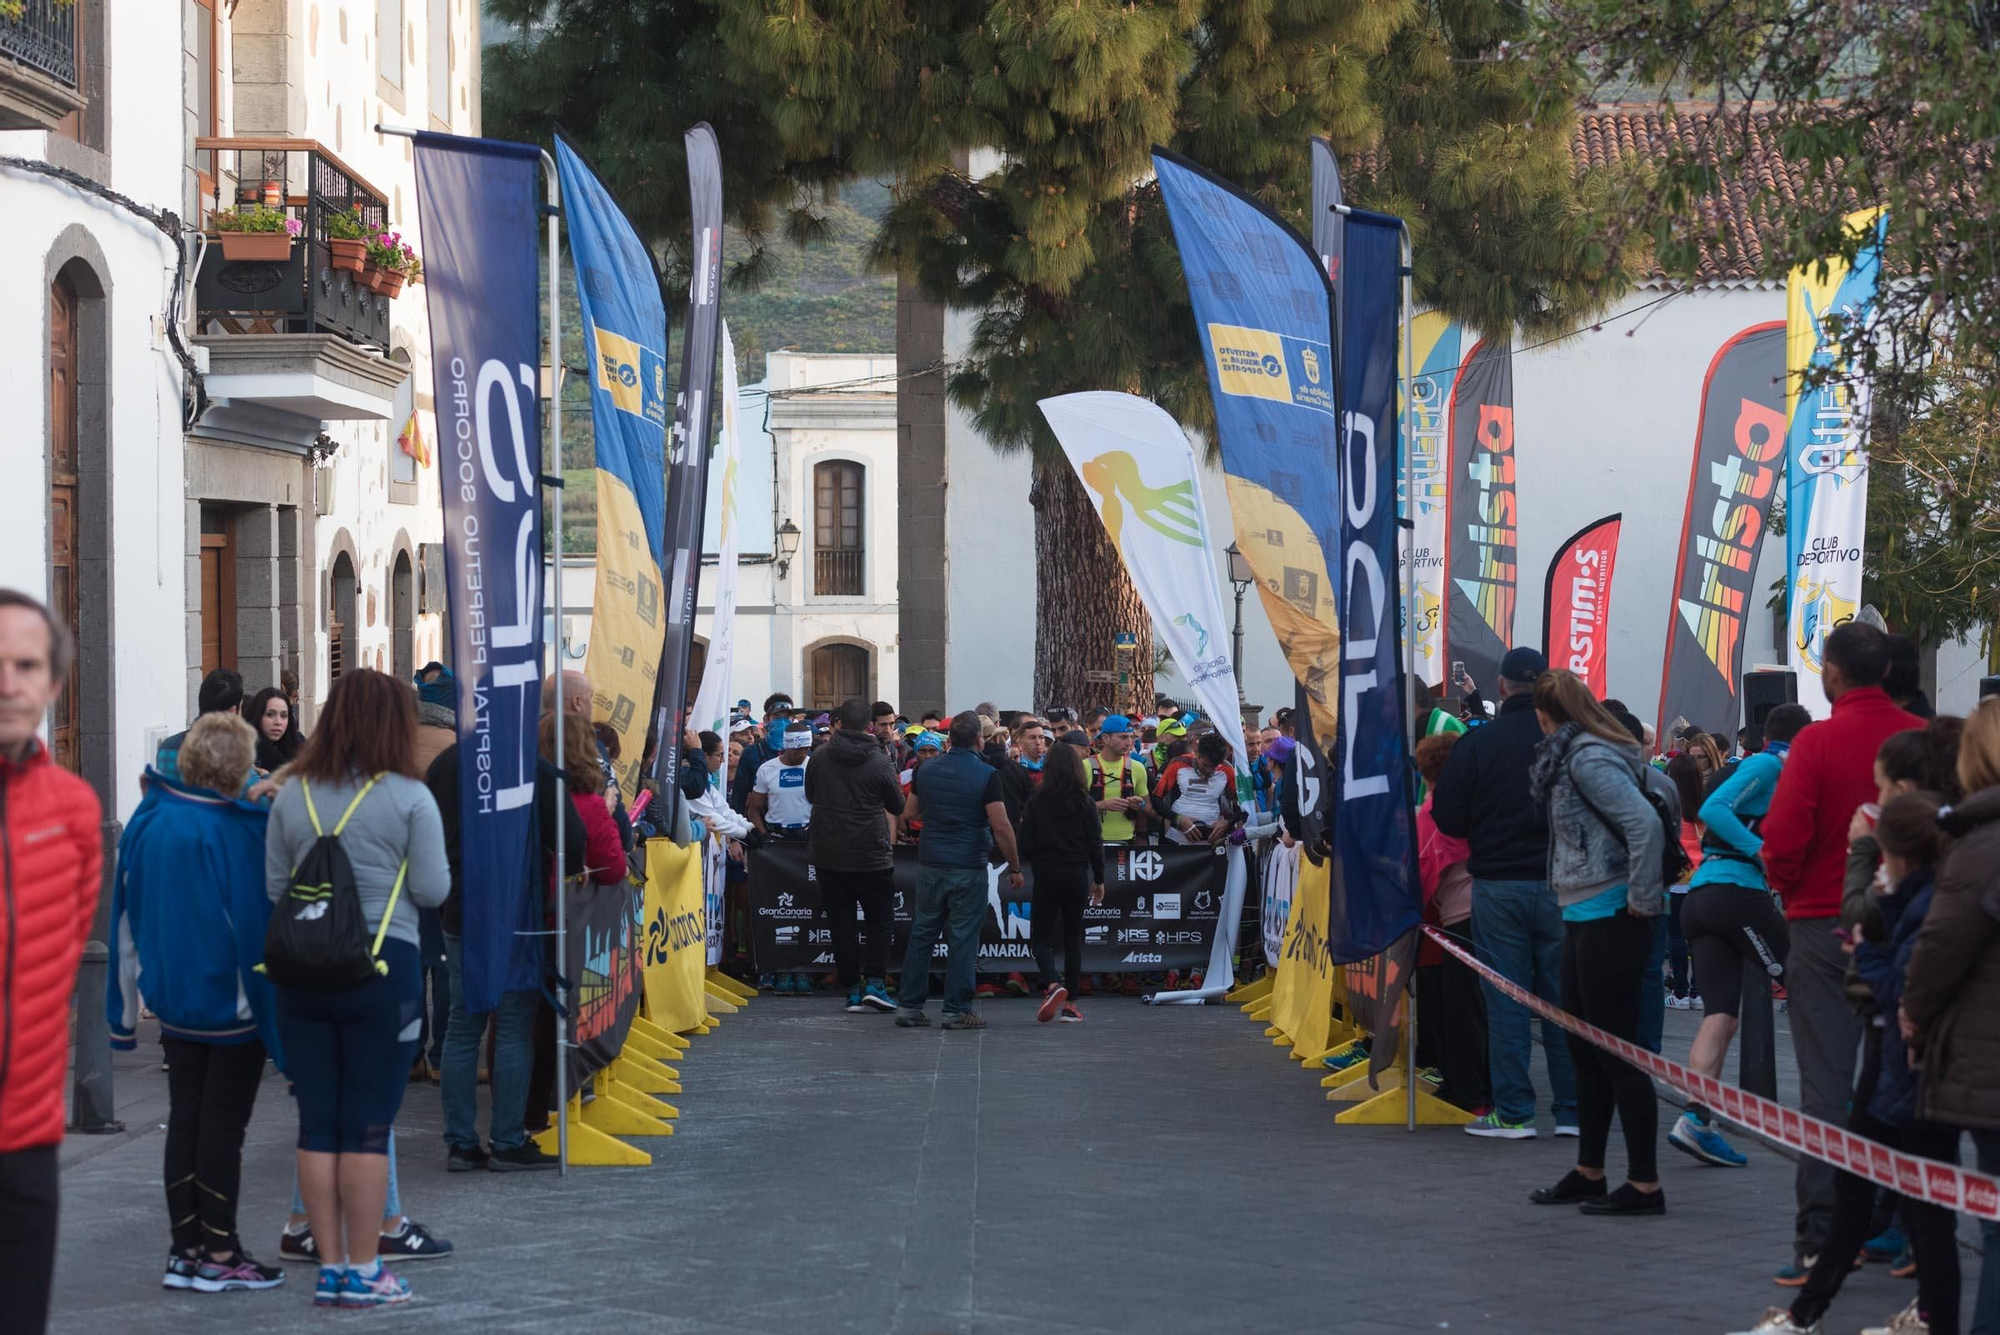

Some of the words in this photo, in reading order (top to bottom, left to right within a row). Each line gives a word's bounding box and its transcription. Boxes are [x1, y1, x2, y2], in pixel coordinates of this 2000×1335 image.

[1453, 404, 1517, 650] Arista
[1678, 397, 1787, 697] Arista
[1812, 536, 1839, 551] CLUB
[1402, 548, 1430, 559] CUB
[1796, 548, 1860, 566] DEPORTIVO
[1398, 557, 1444, 569] PRTIVO
[758, 907, 812, 917] GranCanaria
[1166, 932, 1202, 942] HPS
[932, 944, 949, 958] GR
[977, 944, 1031, 958] ANARIA
[1121, 951, 1163, 964] Arista
